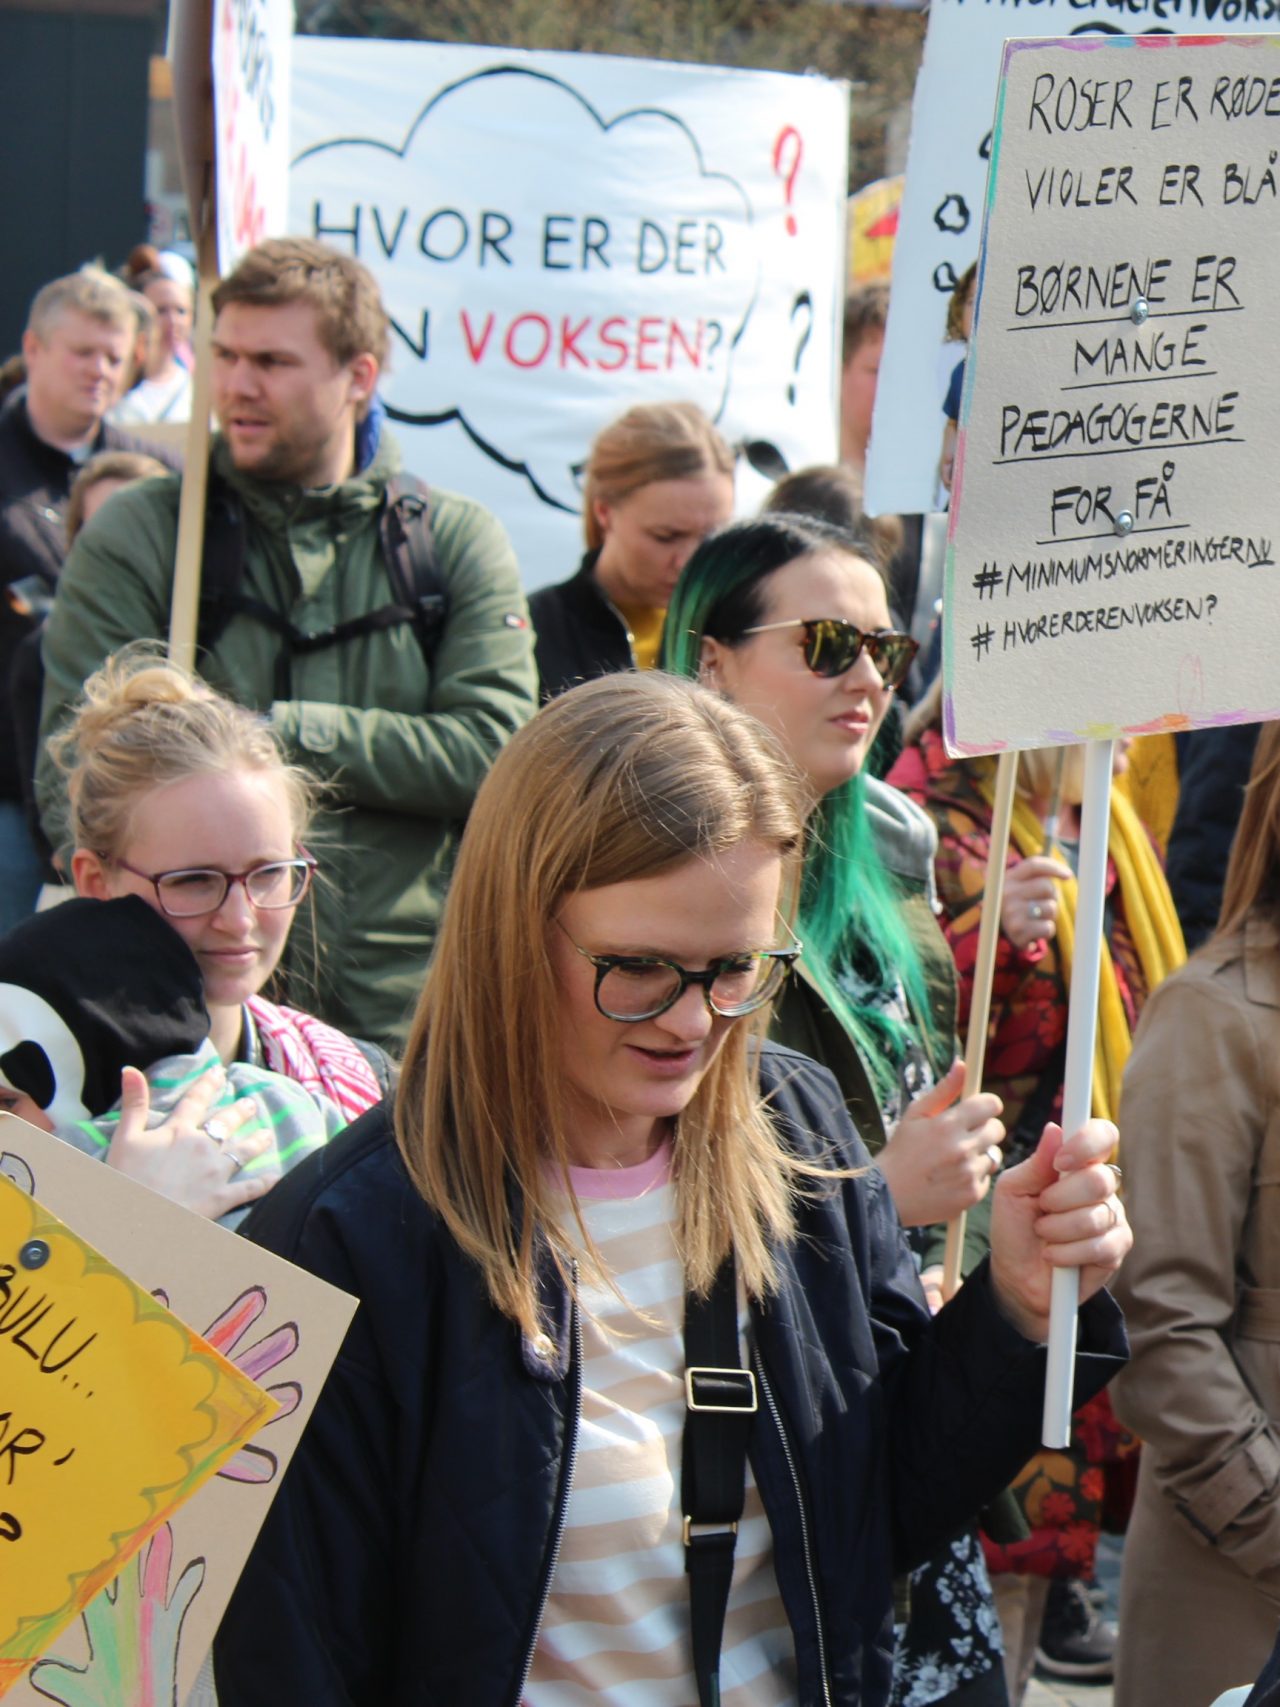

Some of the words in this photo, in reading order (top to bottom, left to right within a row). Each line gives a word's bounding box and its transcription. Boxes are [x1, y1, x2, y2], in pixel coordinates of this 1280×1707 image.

[1029, 73, 1134, 134] ROSER
[1151, 76, 1198, 130] ER
[1025, 165, 1138, 213] VIOLER
[1159, 164, 1204, 207] ER
[1224, 150, 1278, 205] BLÅ
[314, 202, 512, 268] HVOR
[541, 214, 611, 271] ER
[637, 217, 727, 274] DER
[1015, 258, 1172, 317] BØRNENE
[1192, 256, 1240, 309] ER
[461, 309, 722, 372] VOKSEN?
[1074, 325, 1208, 376] MANGE
[1000, 392, 1240, 457] PÆDAGOGERNE
[1051, 485, 1119, 536] FOR
[1134, 461, 1176, 519] FÅ
